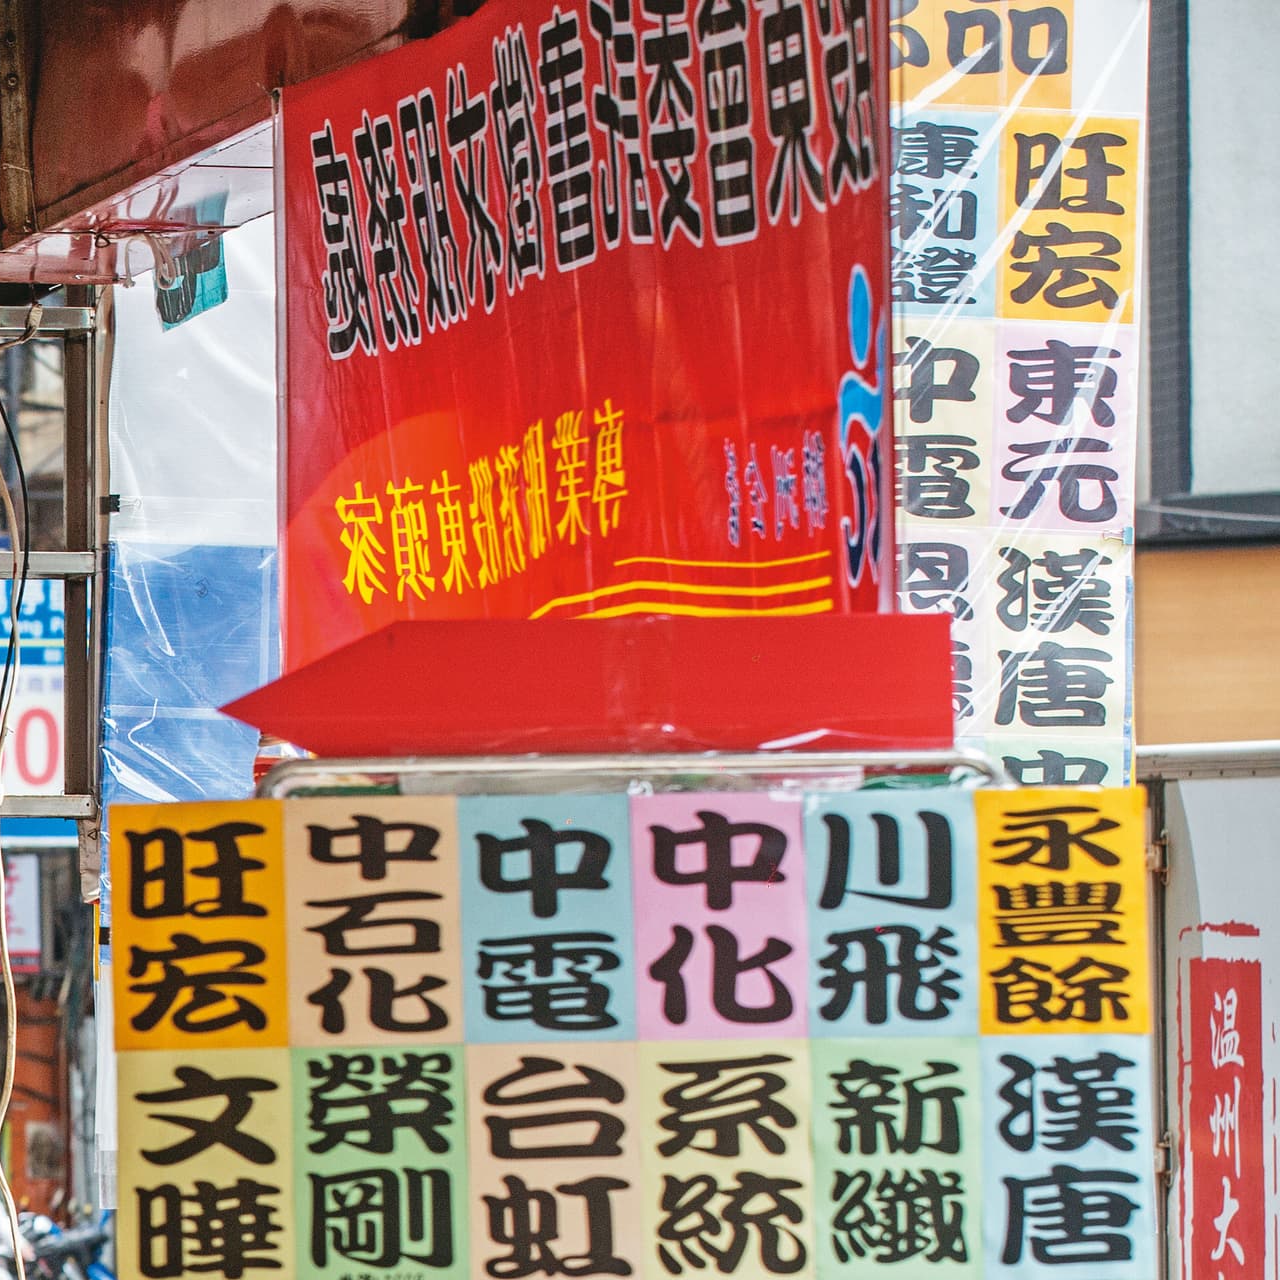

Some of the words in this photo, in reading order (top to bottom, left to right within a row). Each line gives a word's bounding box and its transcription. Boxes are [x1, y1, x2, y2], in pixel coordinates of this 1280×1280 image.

[1010, 133, 1128, 309] 旺宏
[1000, 340, 1122, 523] 東元
[896, 542, 975, 720] 恩
[994, 547, 1115, 727] 漢唐
[125, 821, 268, 1033] 旺宏
[306, 815, 449, 1034] 中石化
[474, 818, 621, 1032] 中電
[649, 810, 793, 1025] 中化
[818, 811, 961, 1025] 川飛
[991, 806, 1129, 1024] 永豐餘
[134, 1065, 283, 1280] 文曄
[307, 1052, 454, 1269] 榮剛
[482, 1056, 633, 1280] 台虹
[658, 1054, 807, 1275] 系統
[829, 1059, 968, 1264] 新纖
[998, 1052, 1140, 1265] 漢唐
